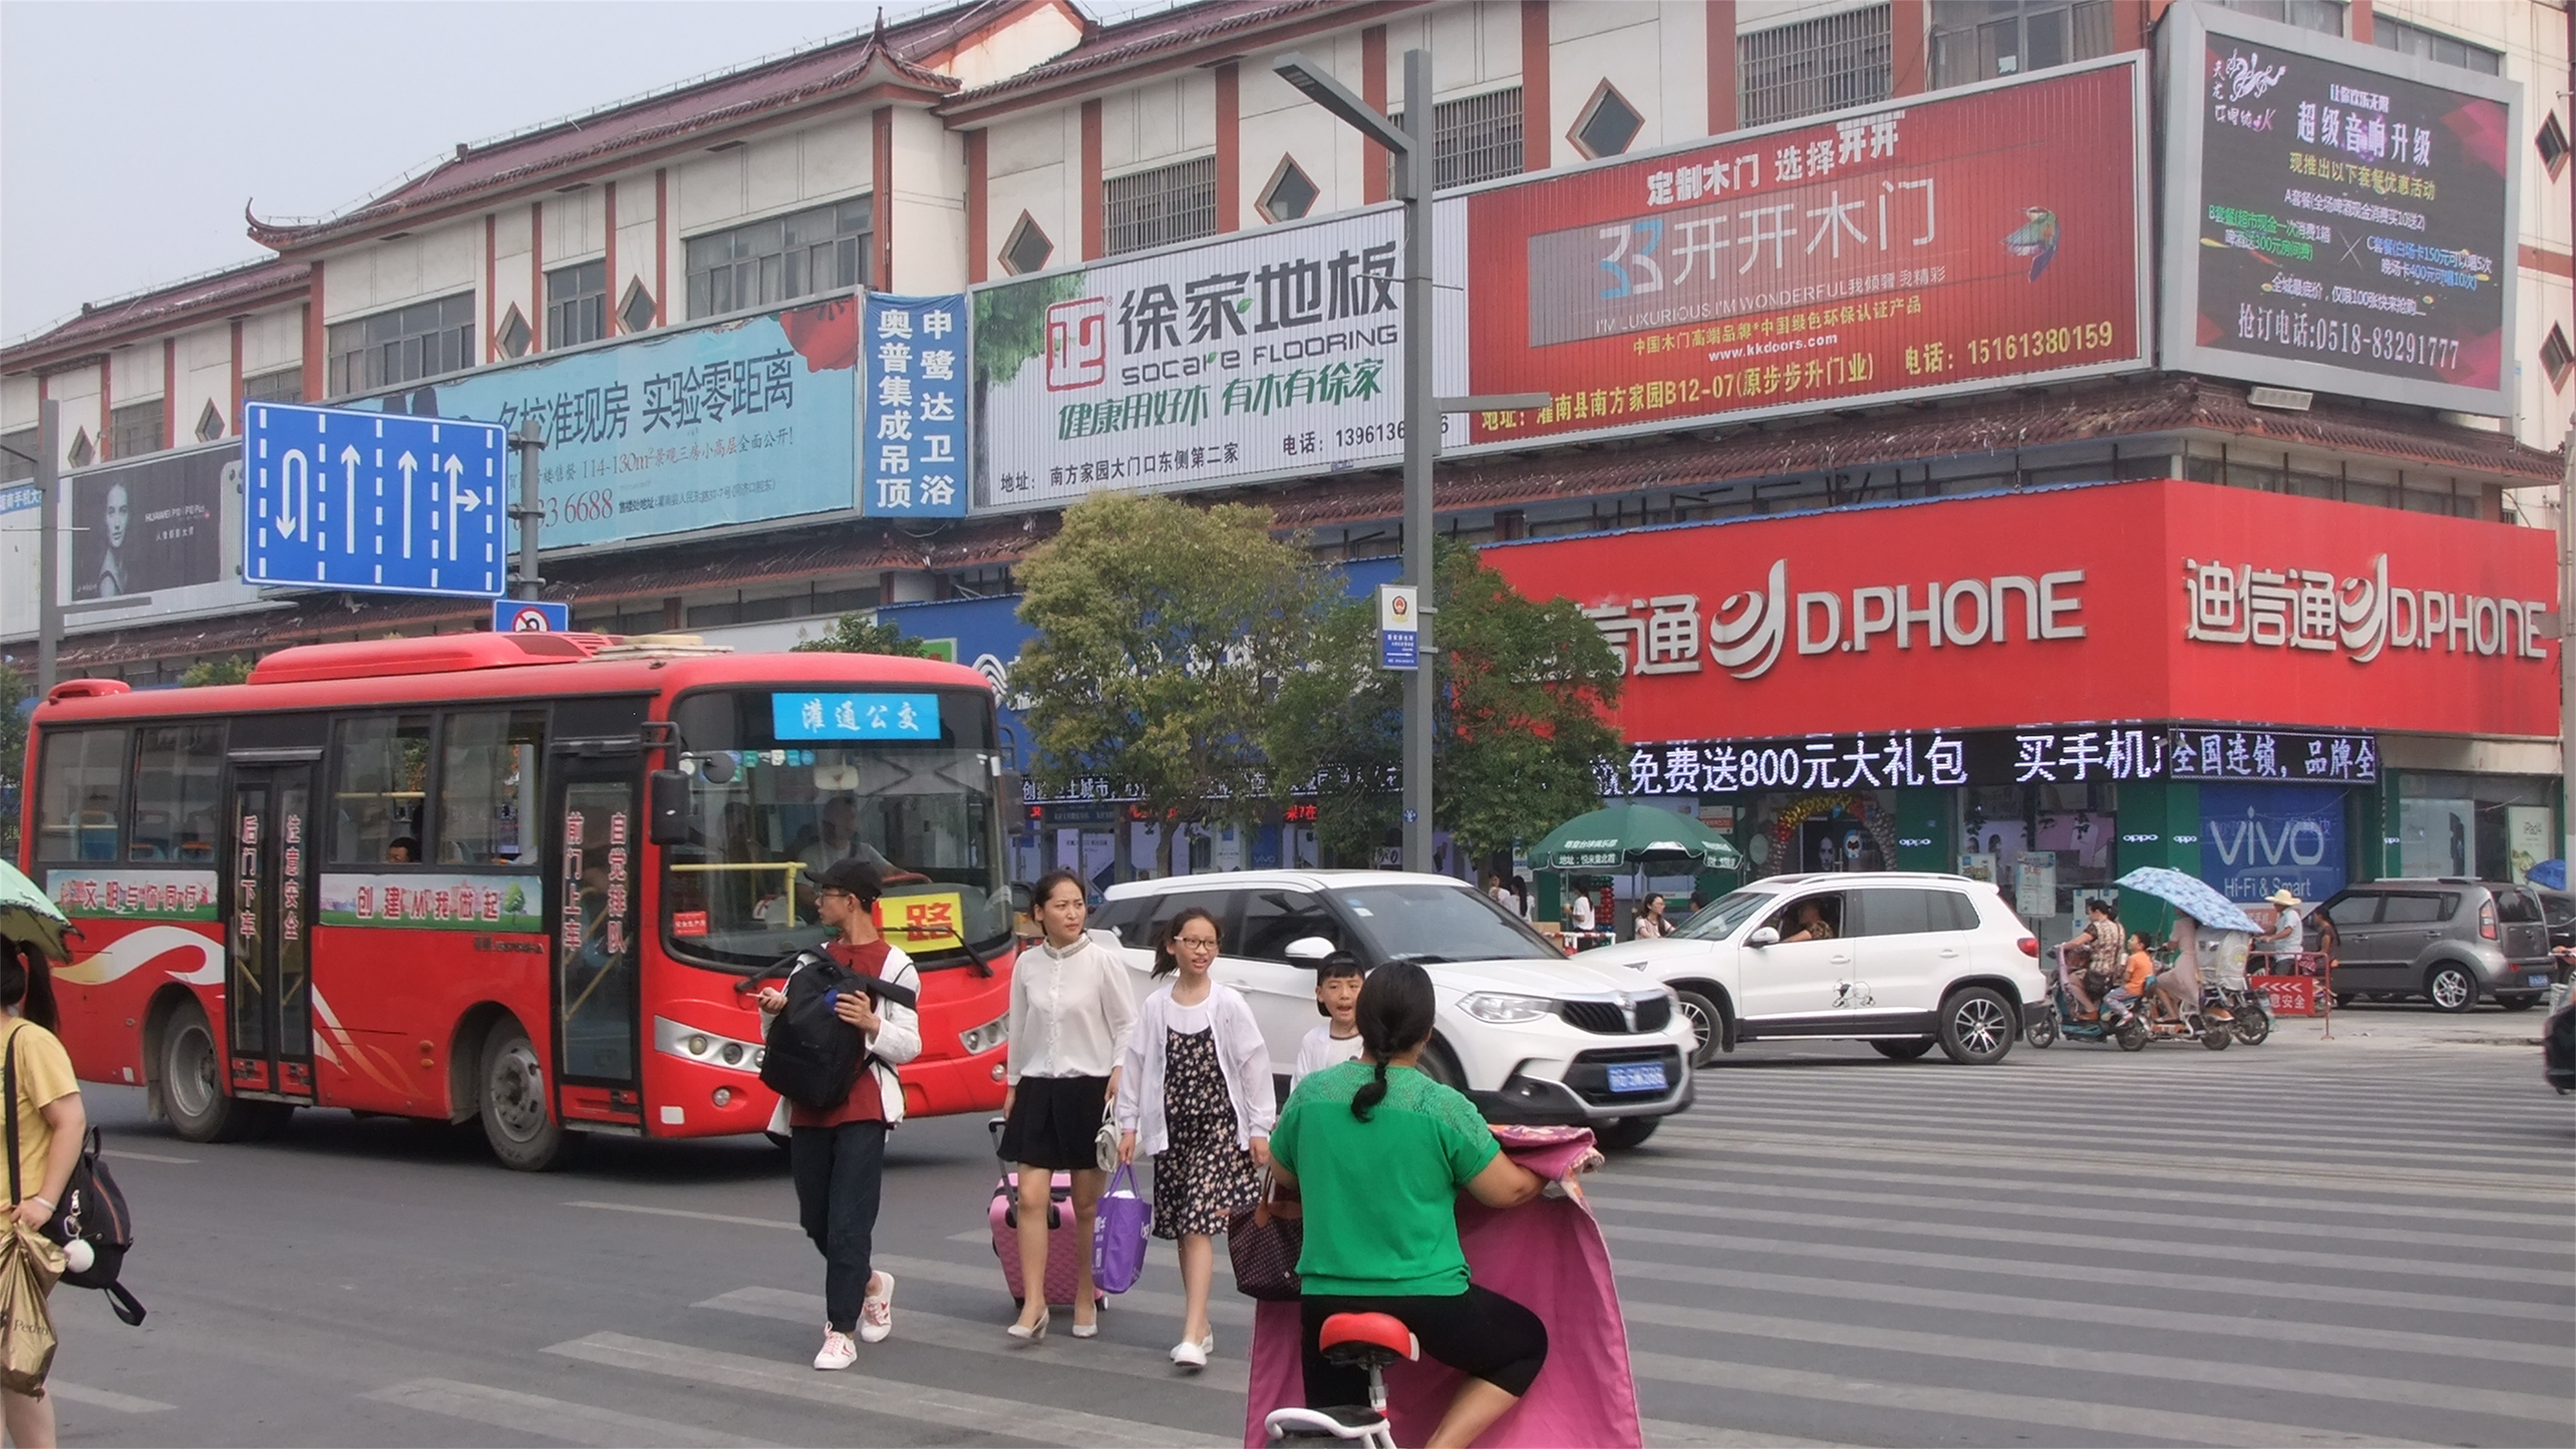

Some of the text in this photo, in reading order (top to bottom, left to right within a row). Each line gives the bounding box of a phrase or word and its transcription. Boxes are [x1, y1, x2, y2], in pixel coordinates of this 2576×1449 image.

[2289, 152, 2436, 200] 现推出以下套餐优惠活动
[2297, 101, 2430, 167] 超级音响升级
[1647, 154, 1759, 207] 定制木门
[1672, 177, 1935, 286] 开开木门
[1118, 241, 1397, 355] 徐家地板
[1253, 324, 1398, 365] FLOORING
[1708, 333, 1838, 362] www.kkdoors.com
[642, 348, 795, 435] 实验零距离
[877, 309, 913, 509] 奥普集成吊顶
[920, 309, 955, 506] 申鹭达卫浴
[1059, 358, 1384, 440] 健康用好木 有木有徐家
[1797, 569, 2088, 655] D.PHONE
[2182, 558, 2337, 651] 迪信通
[2390, 587, 2548, 659] D.PHONE
[801, 698, 920, 732] 灌通公交
[240, 815, 258, 939] 后门下车
[2210, 805, 2324, 866] vivo
[563, 811, 585, 953] 前门上车
[608, 811, 628, 955] 自觉排队
[2224, 877, 2257, 897] Hi-Fi
